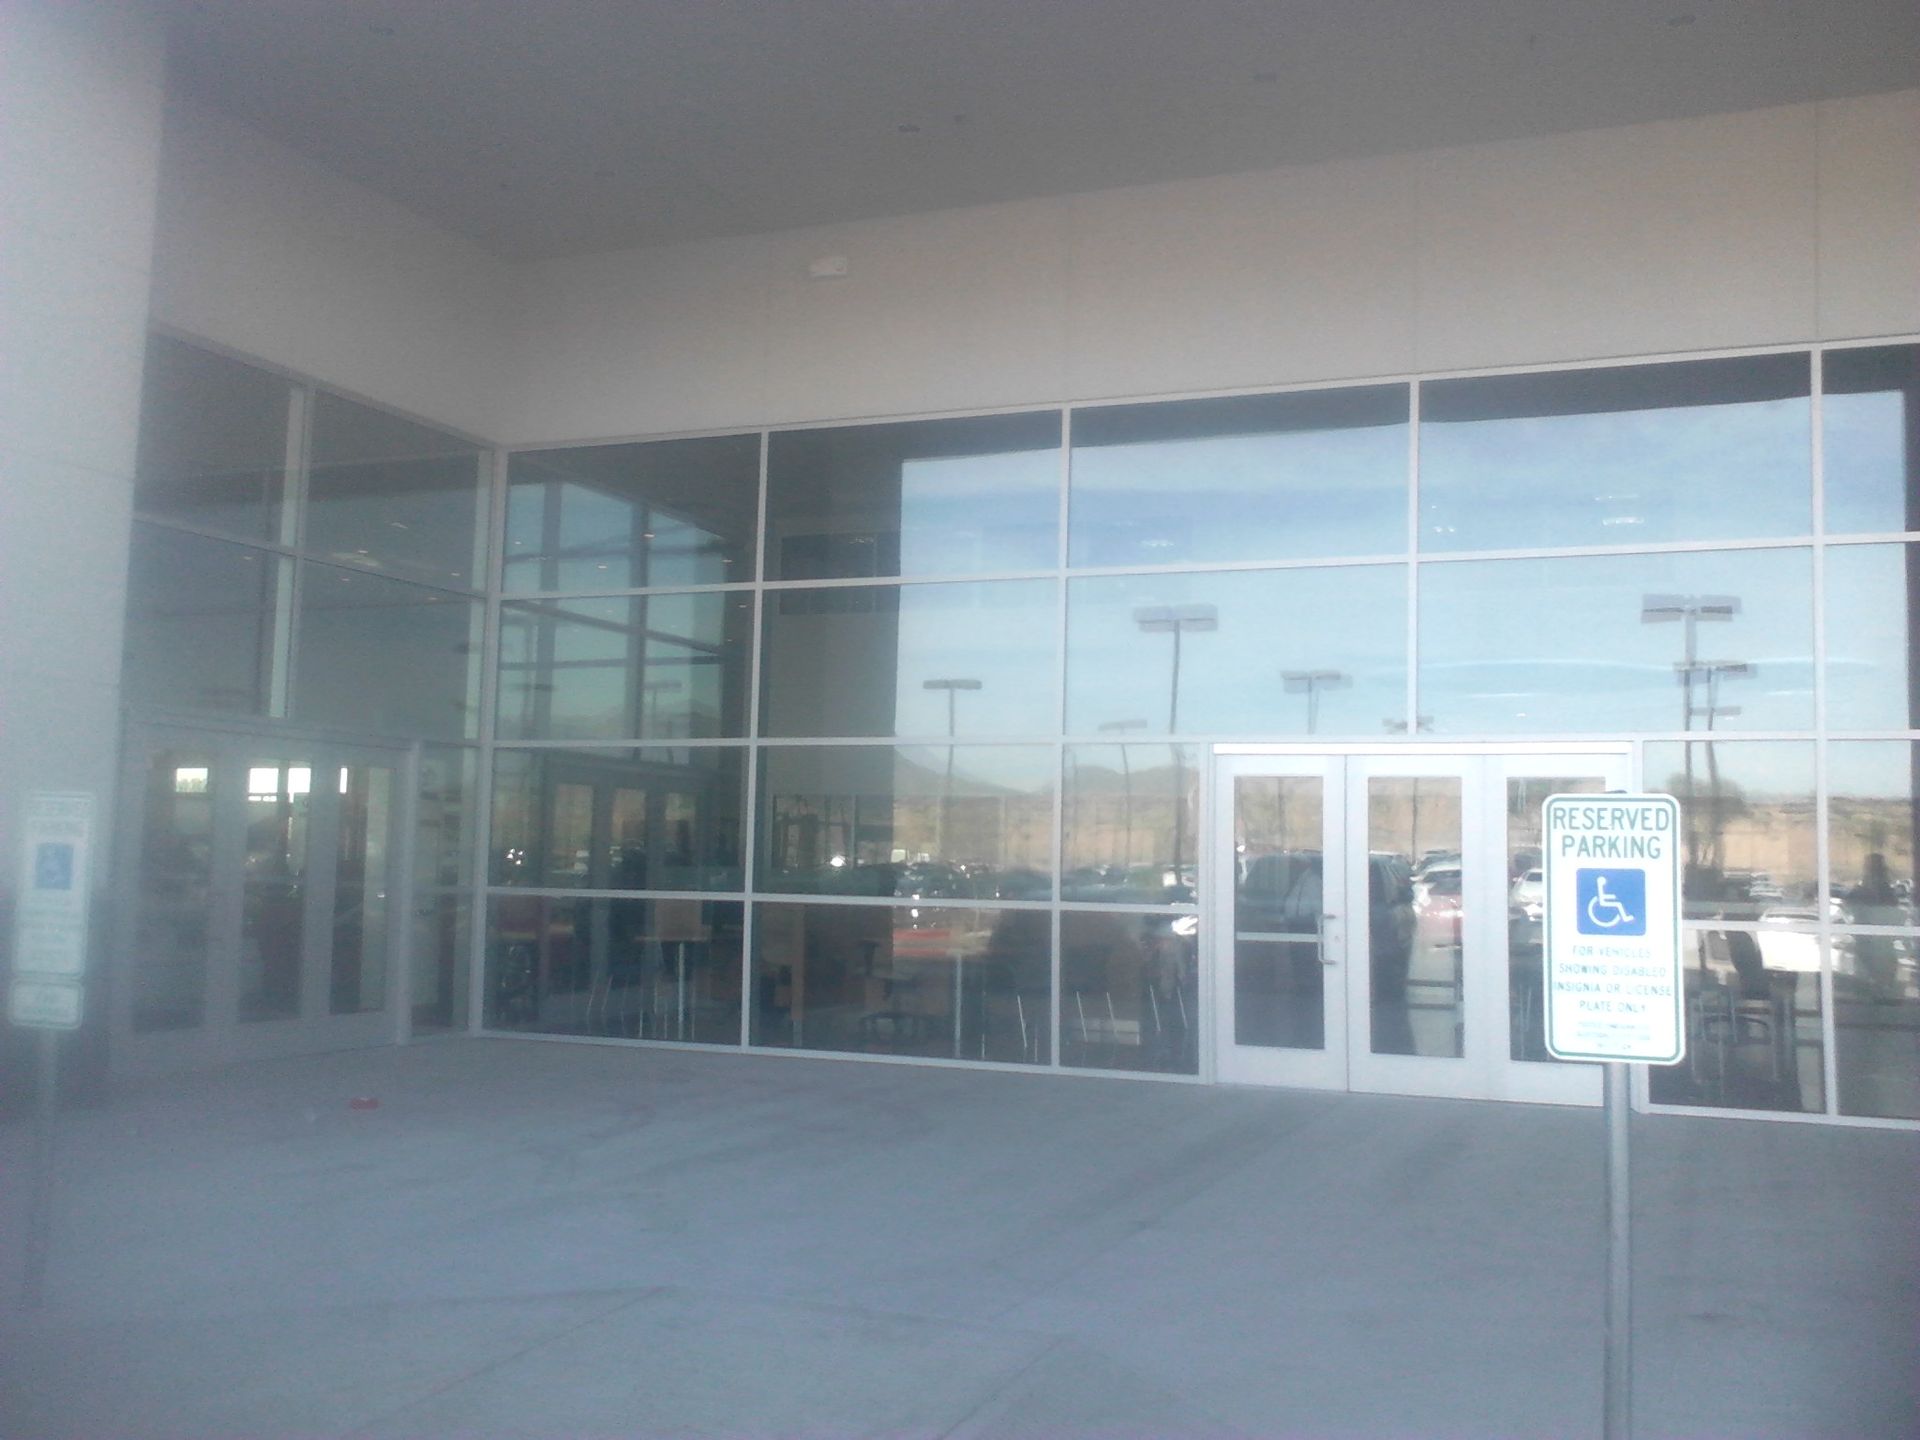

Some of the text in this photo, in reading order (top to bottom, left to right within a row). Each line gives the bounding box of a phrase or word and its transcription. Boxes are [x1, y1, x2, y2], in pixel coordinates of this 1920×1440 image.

[1553, 807, 1669, 831] RESERVED
[1562, 835, 1661, 859] PARKING
[1572, 945, 1652, 958] FOR VEHICLES
[1559, 963, 1666, 977] SHOWING DISABLED
[1552, 981, 1601, 992] INSIGNIA
[1606, 983, 1621, 994] OR
[1579, 1000, 1646, 1013] PLATE ONLY
